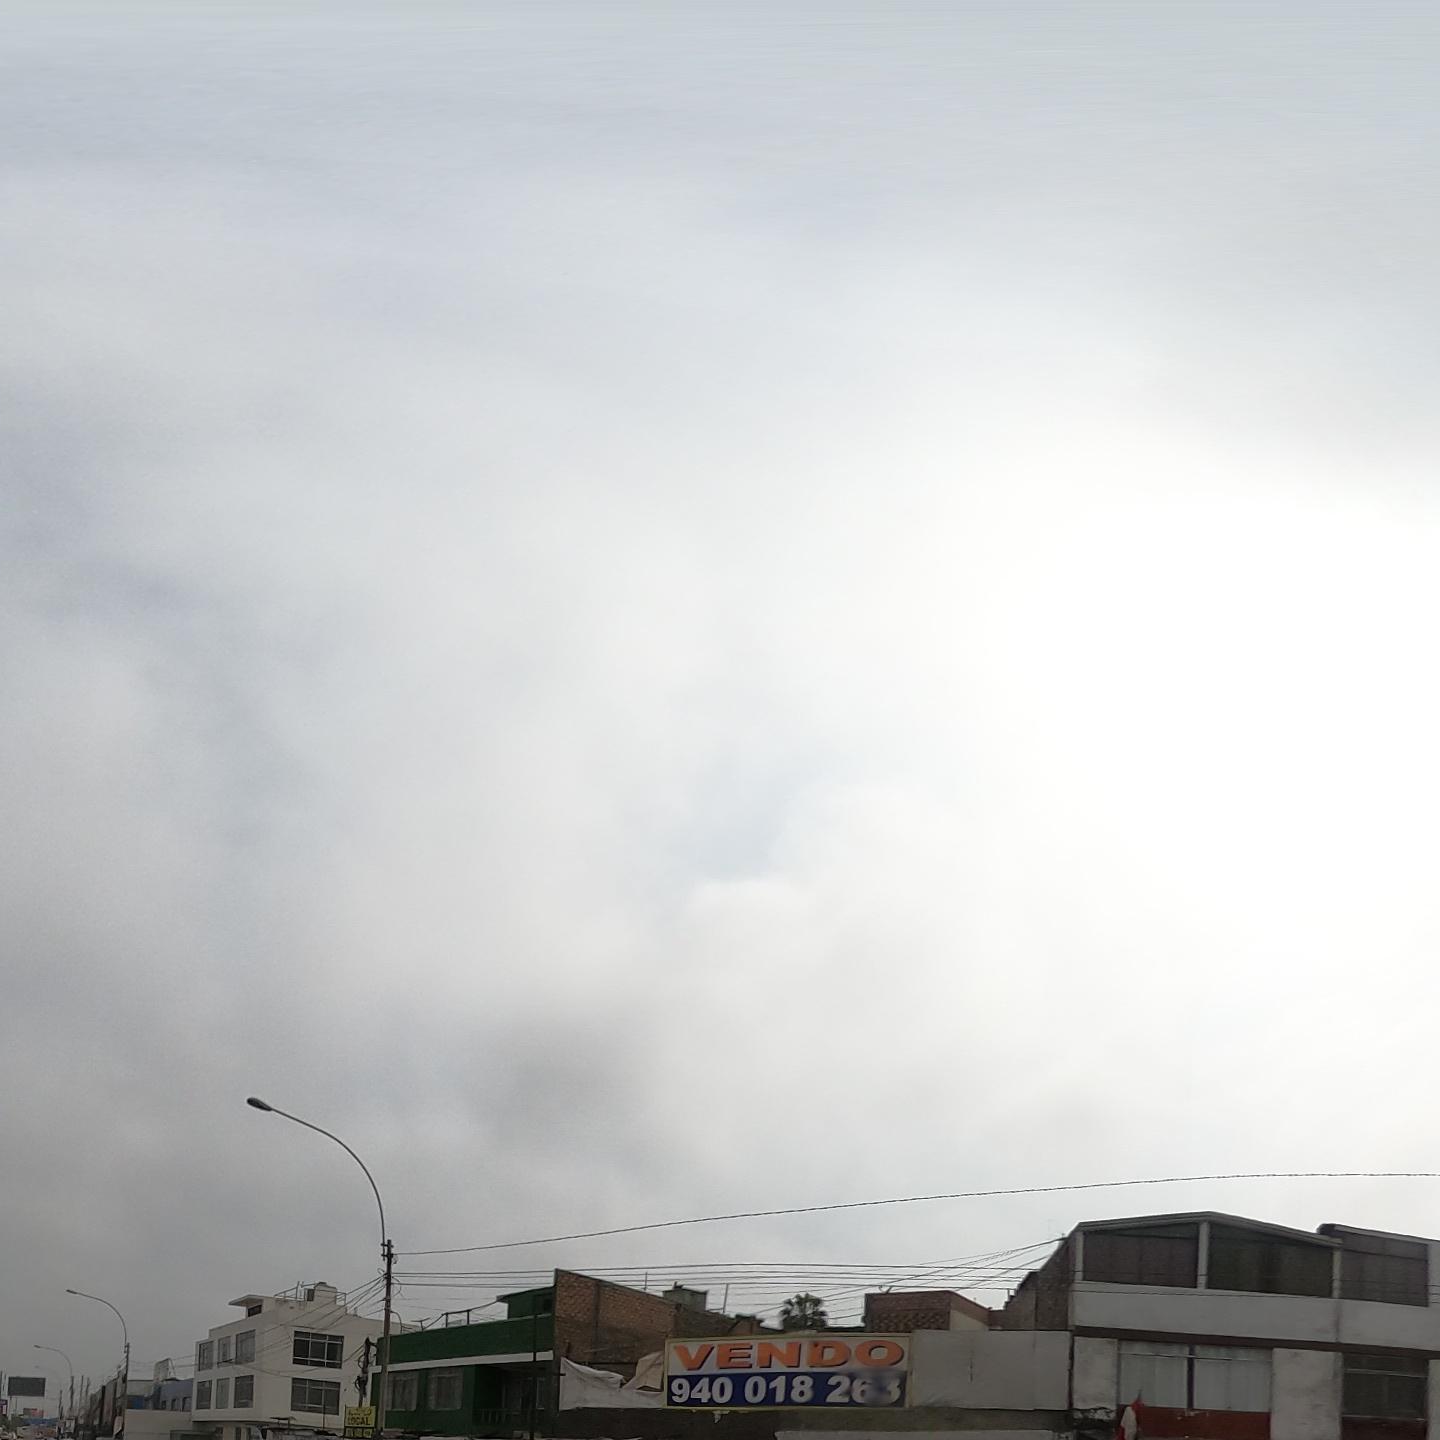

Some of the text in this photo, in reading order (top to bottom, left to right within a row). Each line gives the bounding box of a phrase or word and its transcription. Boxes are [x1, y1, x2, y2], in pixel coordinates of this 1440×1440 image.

[675, 1340, 904, 1371] VENDO
[670, 1376, 733, 1404] 940
[744, 1375, 814, 1405] 018
